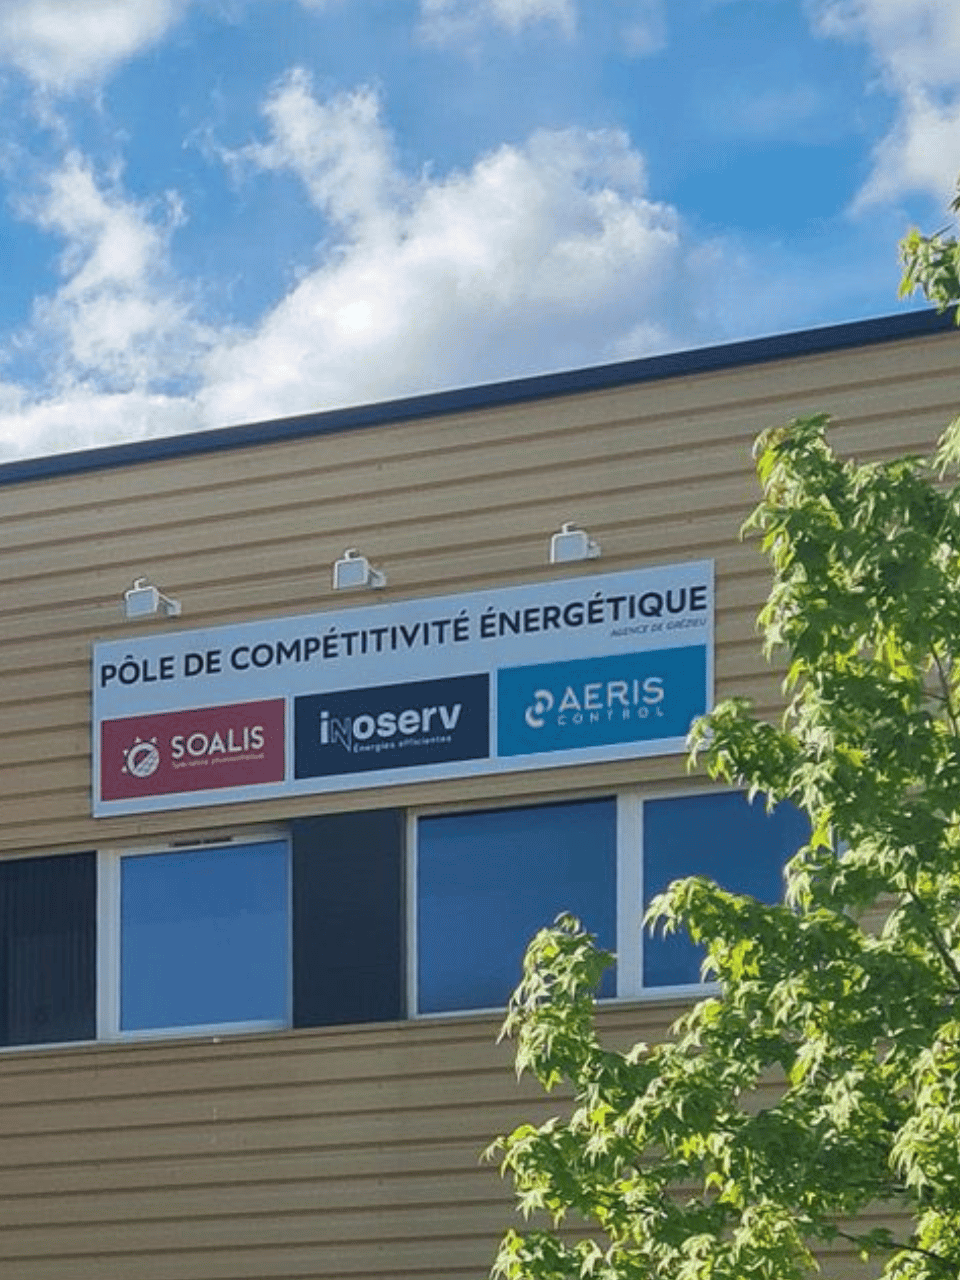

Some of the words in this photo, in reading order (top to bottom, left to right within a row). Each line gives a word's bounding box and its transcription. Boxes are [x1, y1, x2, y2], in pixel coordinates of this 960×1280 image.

[100, 654, 175, 688] PÔLE
[183, 649, 222, 677] DE
[230, 610, 470, 671] COMPÉTITIVITÉ
[480, 585, 708, 639] ÉNERGÉTIQUE
[610, 624, 649, 637] AGENCE
[650, 622, 663, 632] DE
[558, 676, 665, 713] AERIS
[557, 706, 665, 727] CONTROL
[171, 725, 265, 759] SOALIS
